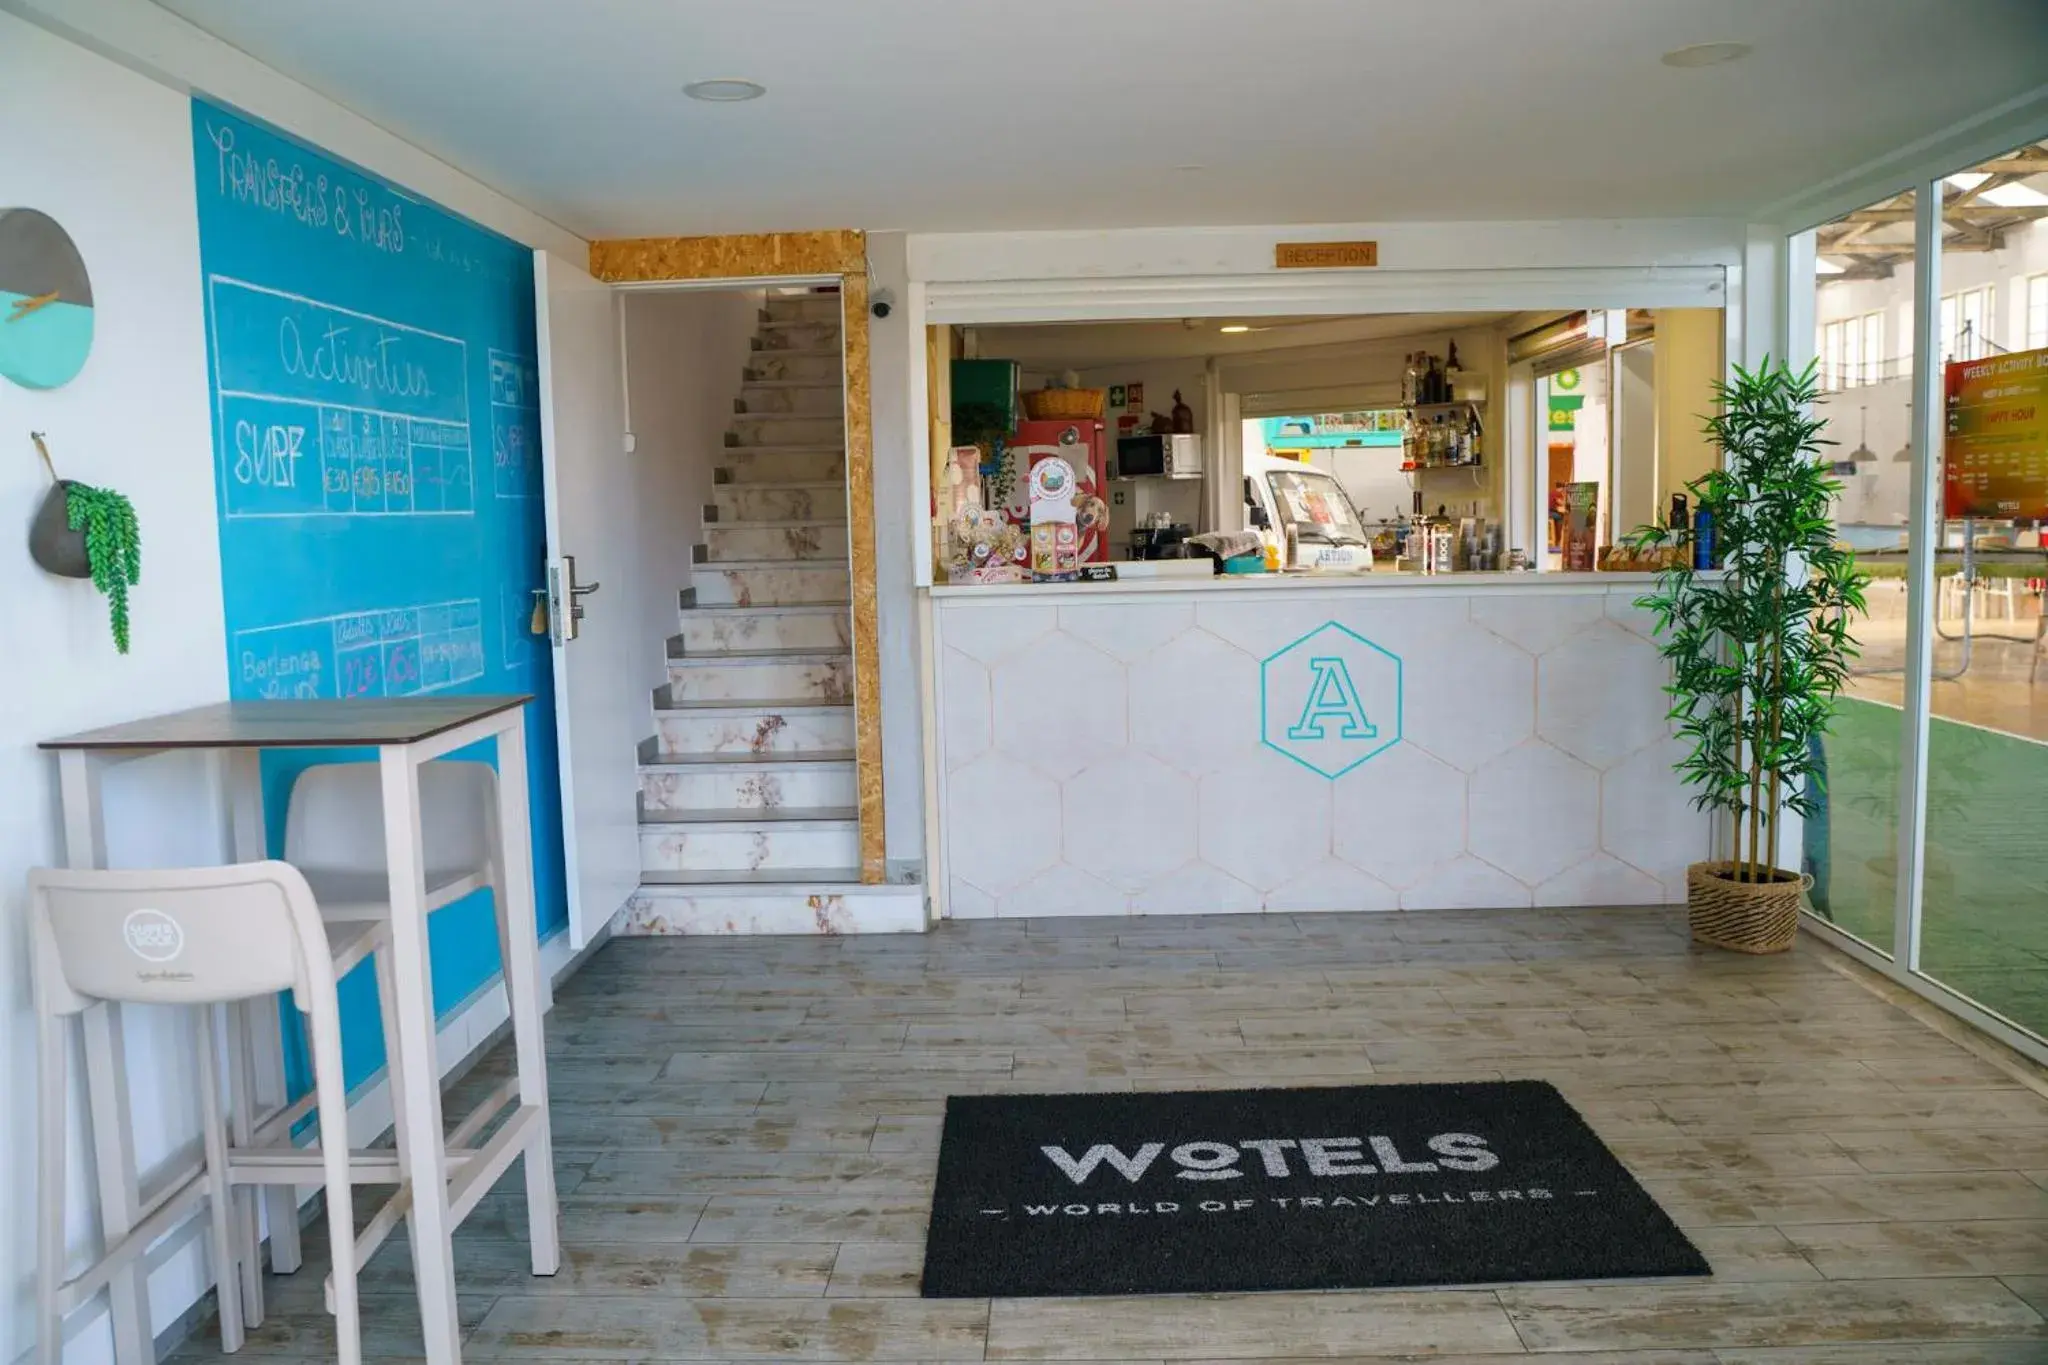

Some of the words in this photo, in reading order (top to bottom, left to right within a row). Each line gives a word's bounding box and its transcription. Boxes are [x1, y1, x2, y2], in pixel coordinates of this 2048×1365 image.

[1284, 247, 1370, 263] RECEPTION
[234, 420, 305, 488] SURF
[1040, 1132, 1500, 1185] WOTELS
[1024, 1202, 1180, 1216] WORLD
[1200, 1200, 1254, 1212] OF
[1271, 1188, 1553, 1208] TRAVELLERS
